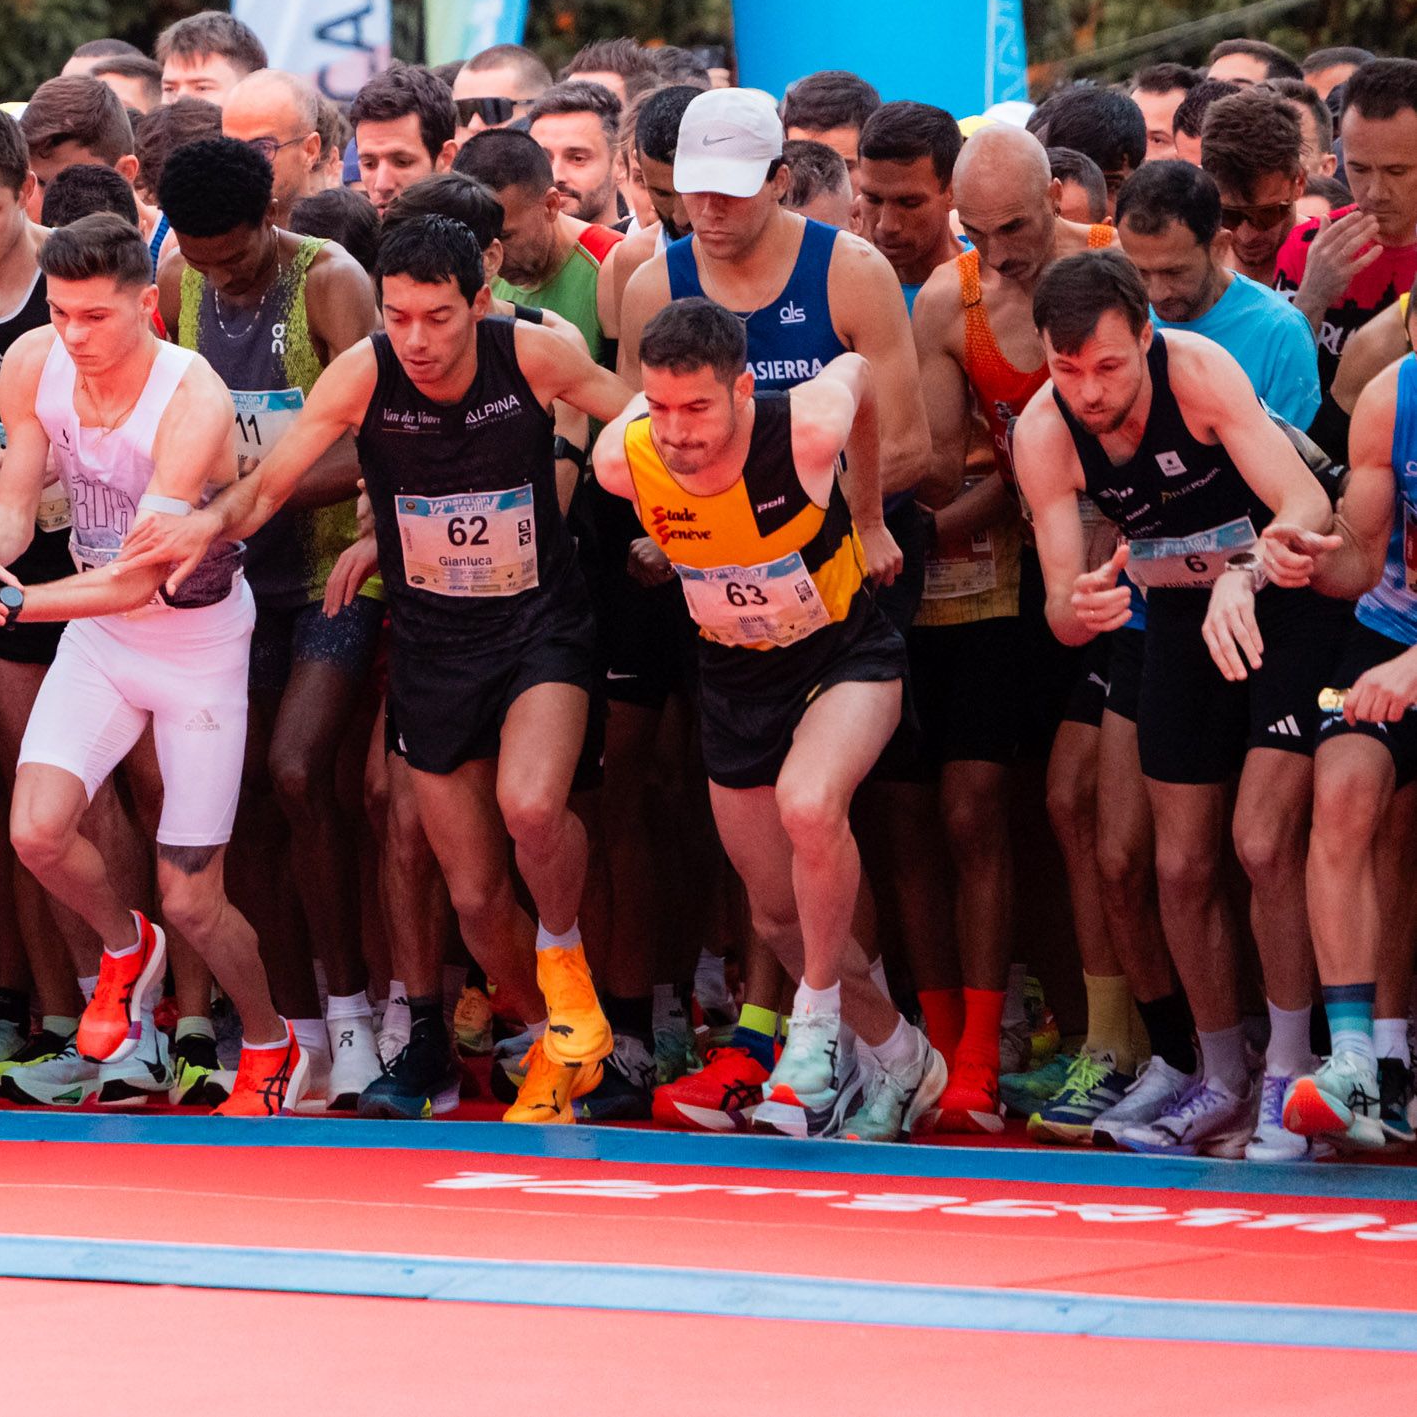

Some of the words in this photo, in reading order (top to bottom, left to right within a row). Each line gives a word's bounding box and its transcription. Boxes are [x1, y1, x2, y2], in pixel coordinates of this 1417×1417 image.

[465, 394, 521, 425] ALPINA
[235, 413, 262, 446] 11
[652, 506, 698, 526] Stade
[447, 516, 490, 547] 62
[657, 524, 712, 546] Genève
[438, 554, 493, 567] Gianluca
[1185, 555, 1208, 573] 6
[725, 582, 769, 608] 63
